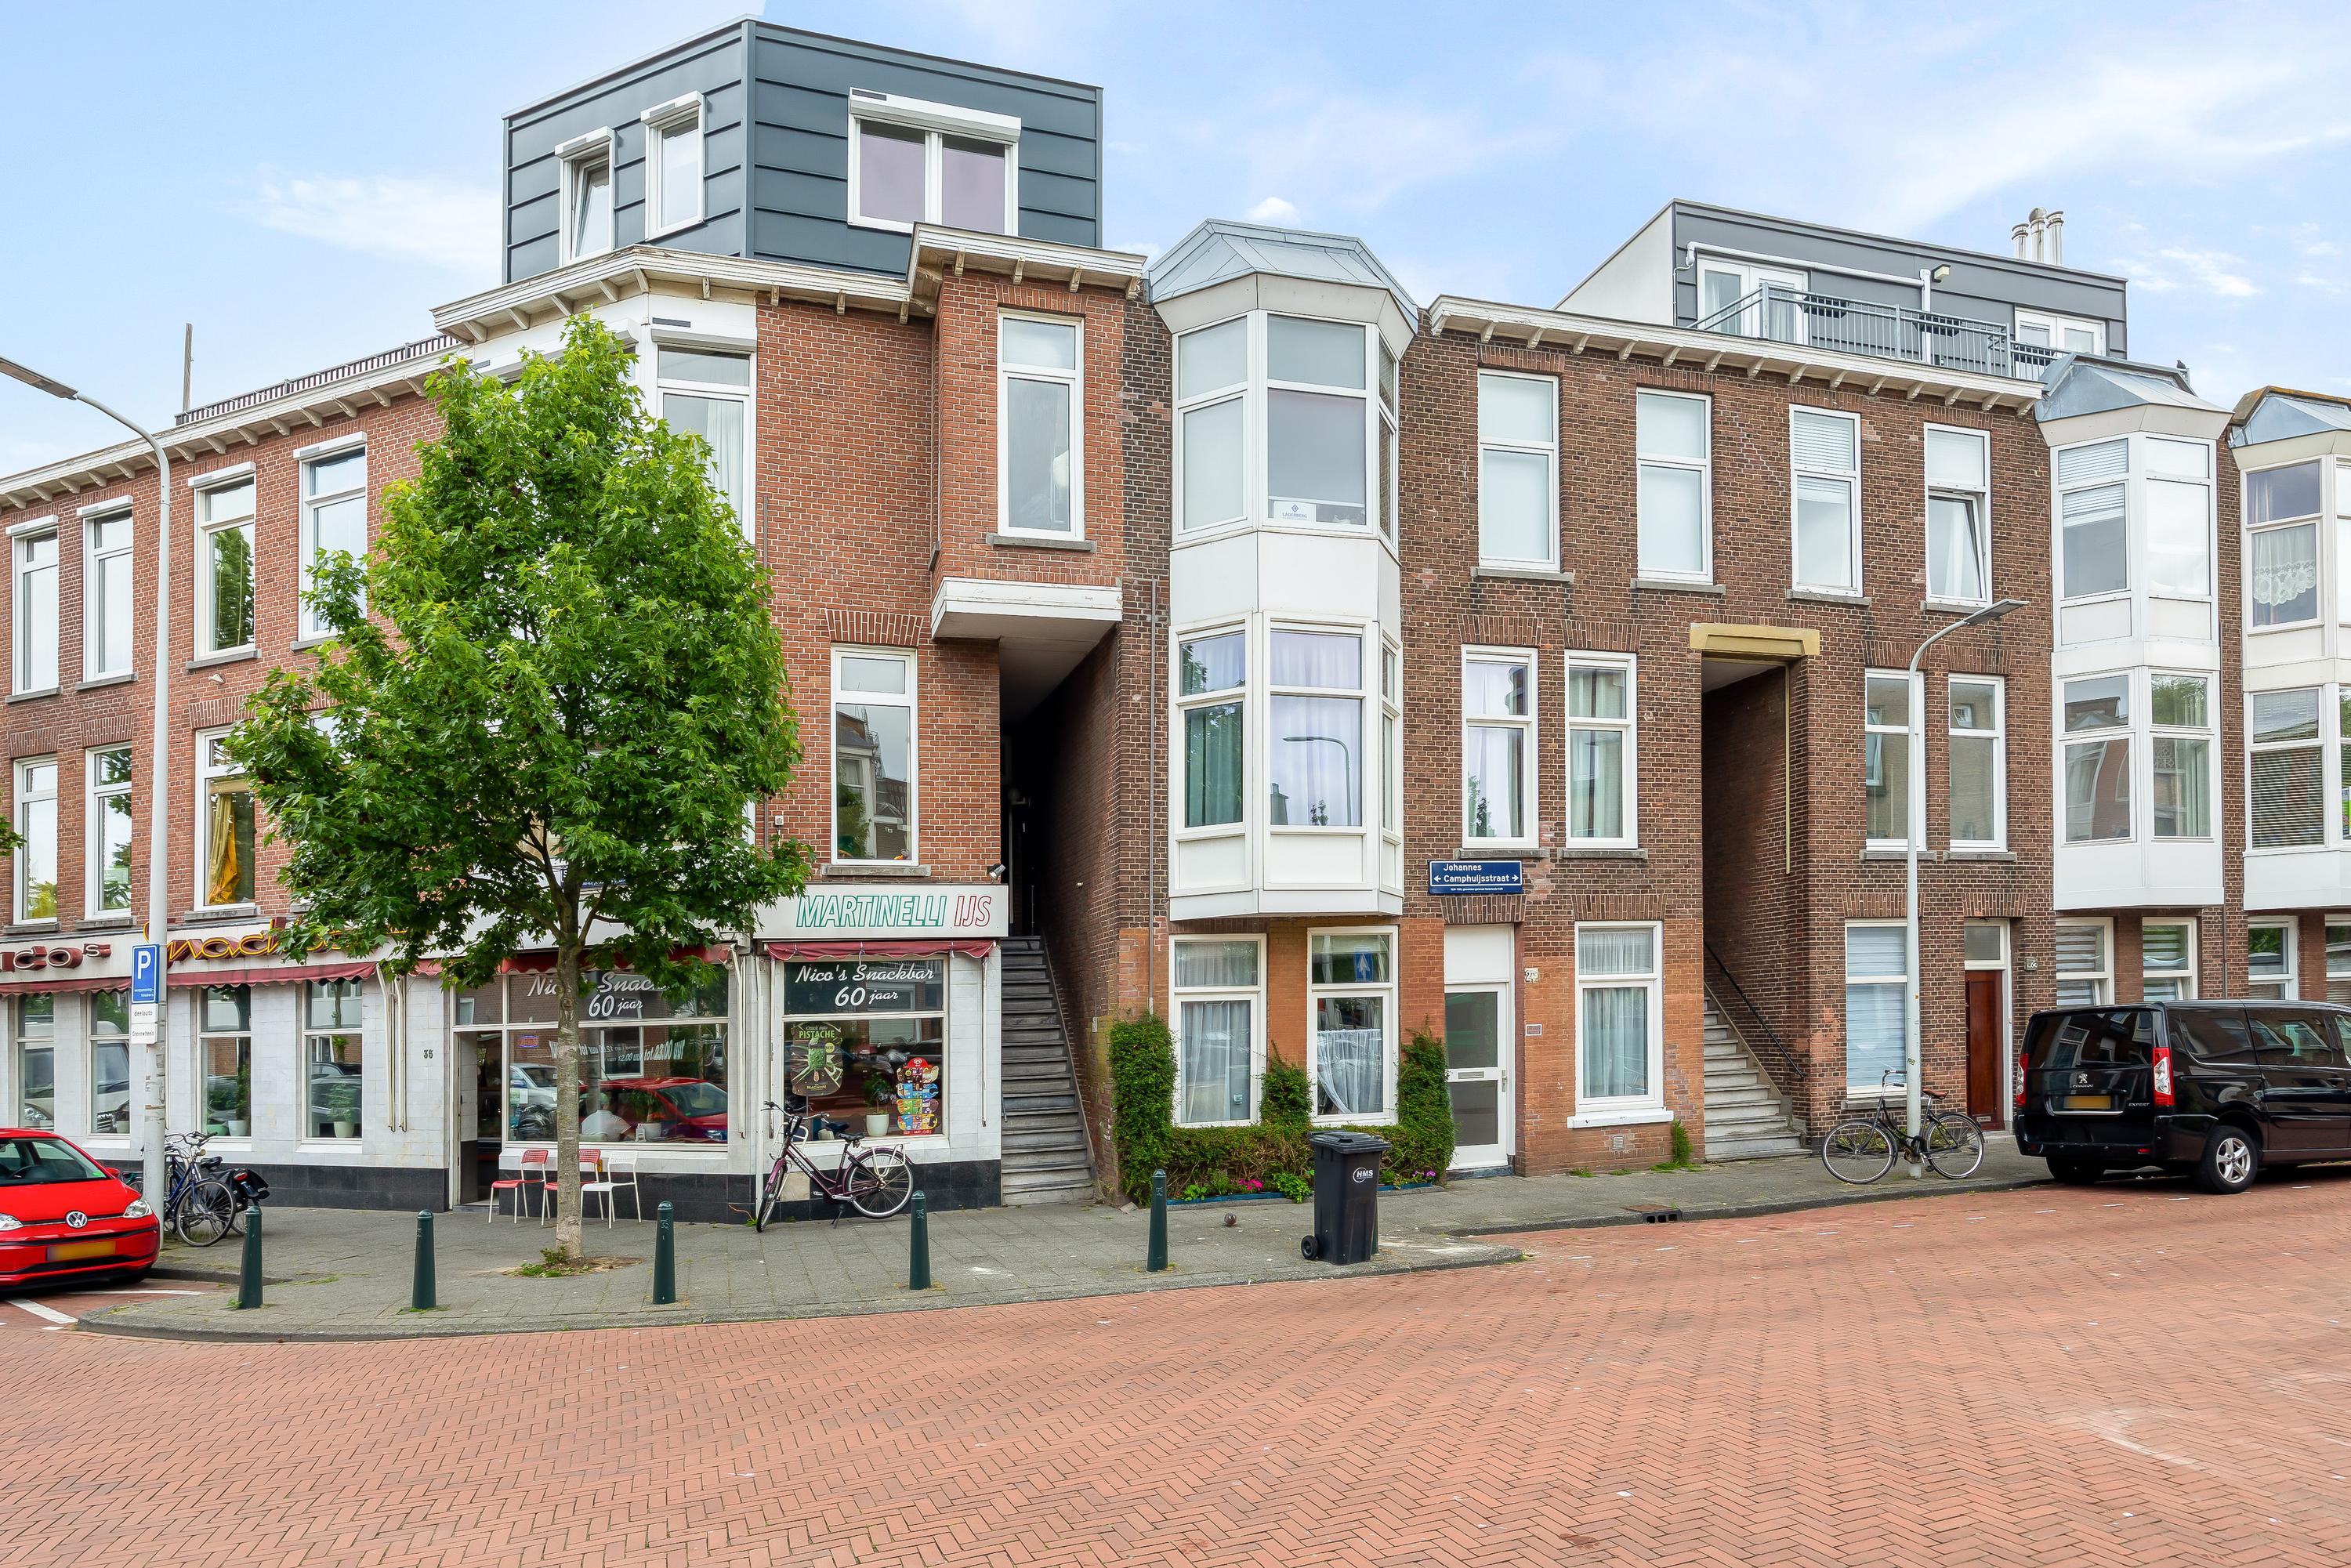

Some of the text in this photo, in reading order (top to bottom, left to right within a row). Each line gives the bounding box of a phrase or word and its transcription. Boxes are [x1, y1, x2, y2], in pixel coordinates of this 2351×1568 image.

[1444, 875, 1509, 884] Camphuijsstraat
[796, 895, 992, 928] MARTINELLI IJS
[137, 951, 151, 980] P
[795, 963, 934, 983] Nico's Snackbar
[589, 994, 643, 1017] 60 jaar
[835, 986, 898, 1007] 60 jaar
[799, 1030, 835, 1039] PISTACHE
[1357, 1169, 1373, 1178] HMS
